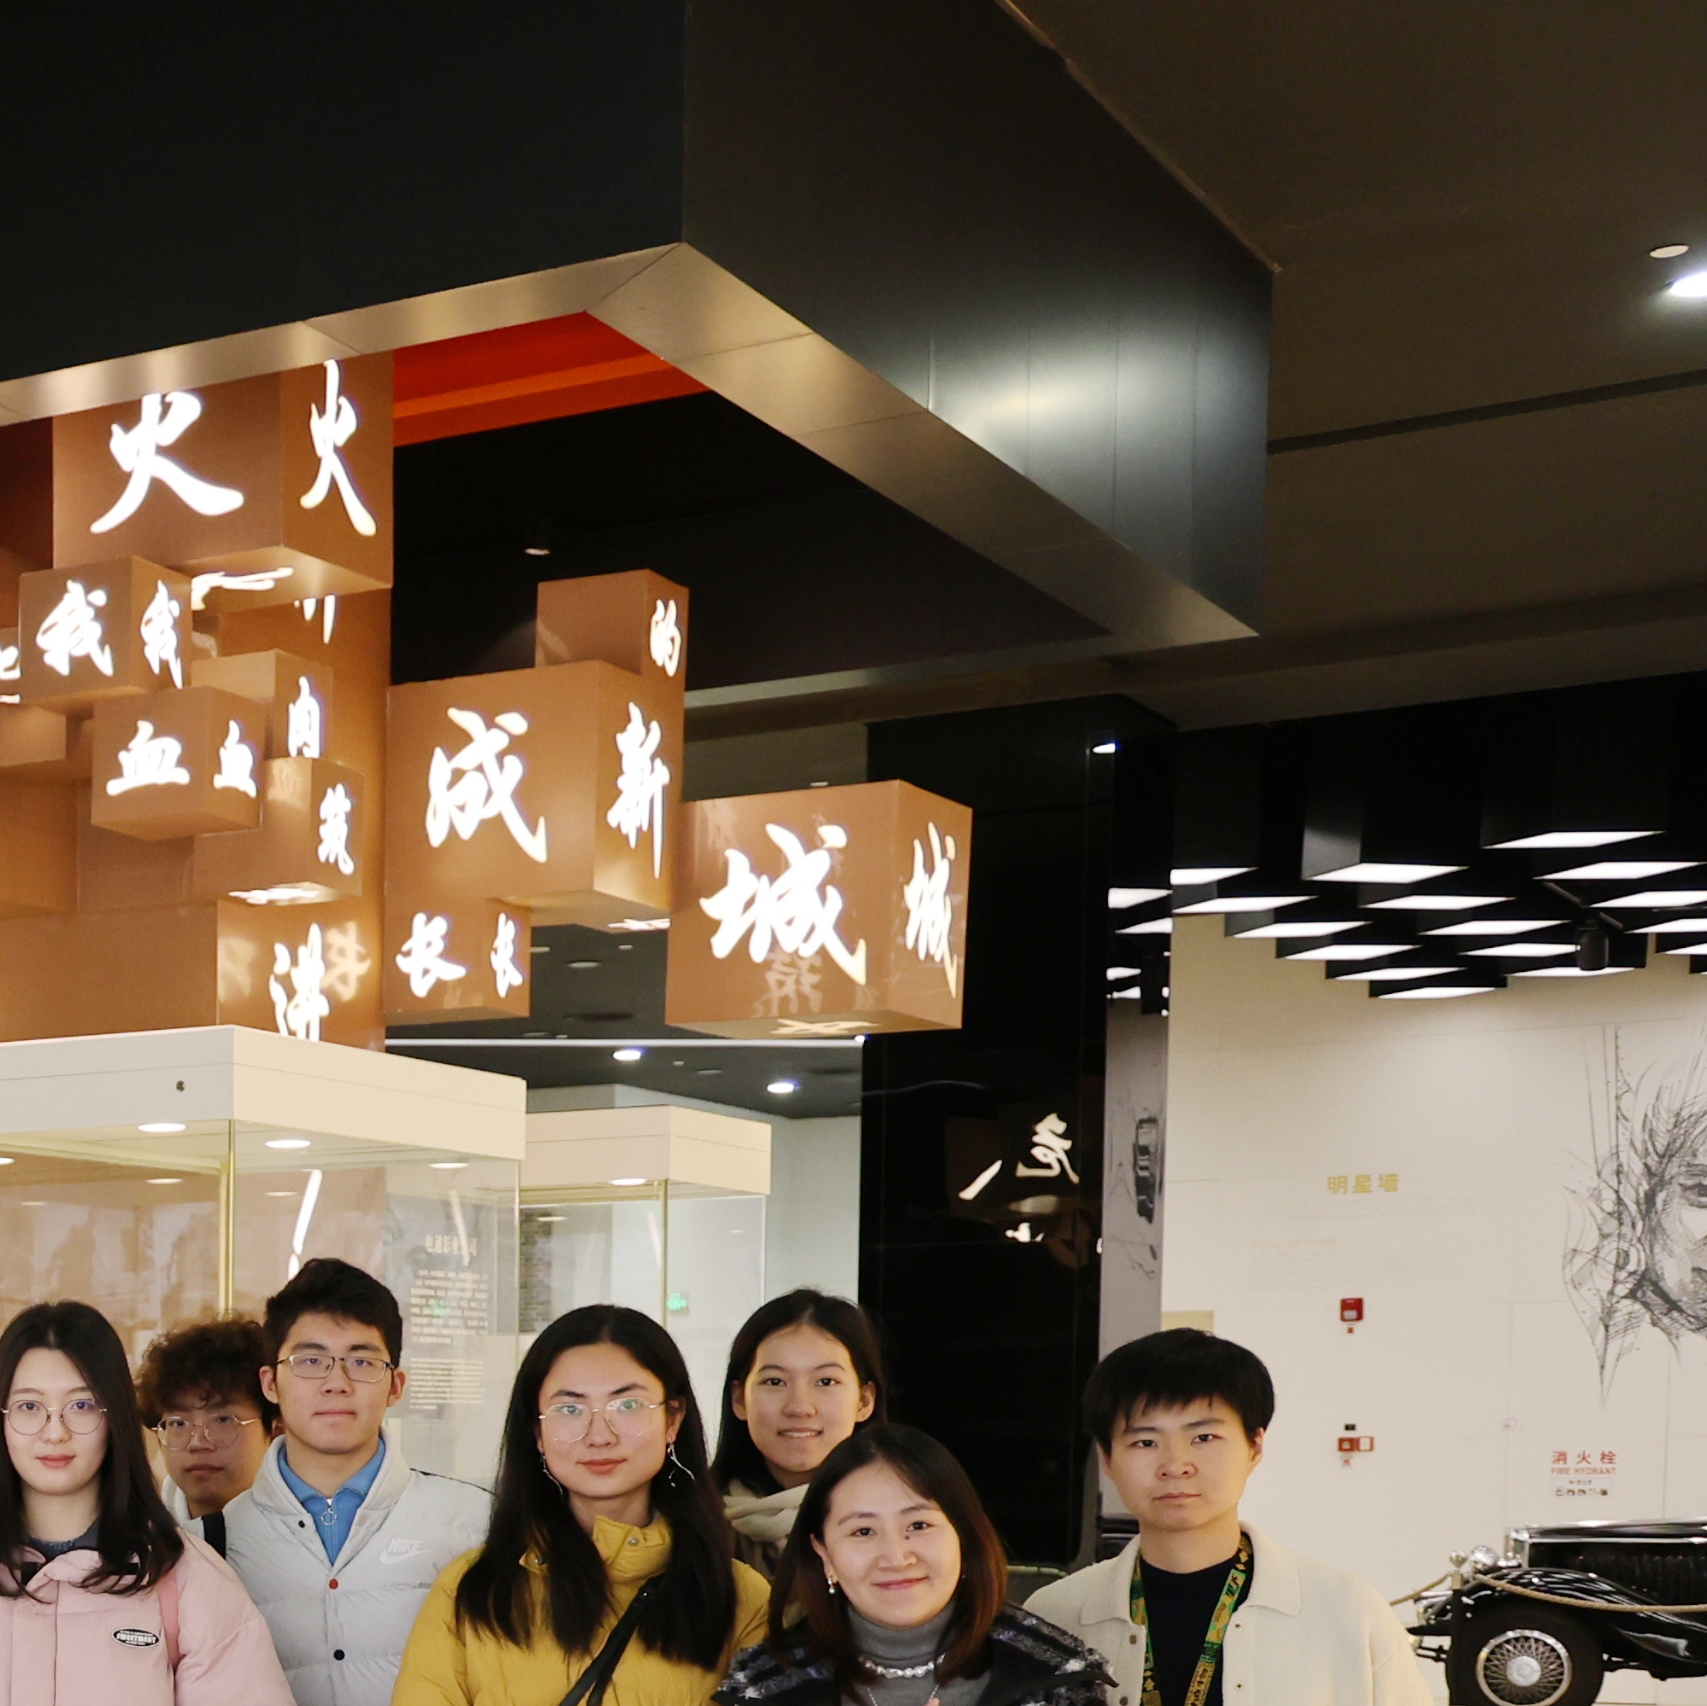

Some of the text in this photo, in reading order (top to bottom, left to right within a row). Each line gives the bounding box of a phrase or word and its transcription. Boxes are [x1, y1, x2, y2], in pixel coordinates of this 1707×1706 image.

[90, 391, 245, 534] 火
[300, 358, 377, 537] 火
[106, 720, 191, 796] 血
[699, 822, 868, 986] 城
[1327, 1173, 1399, 1194] 明星墙
[1552, 1450, 1616, 1465] 消火栓
